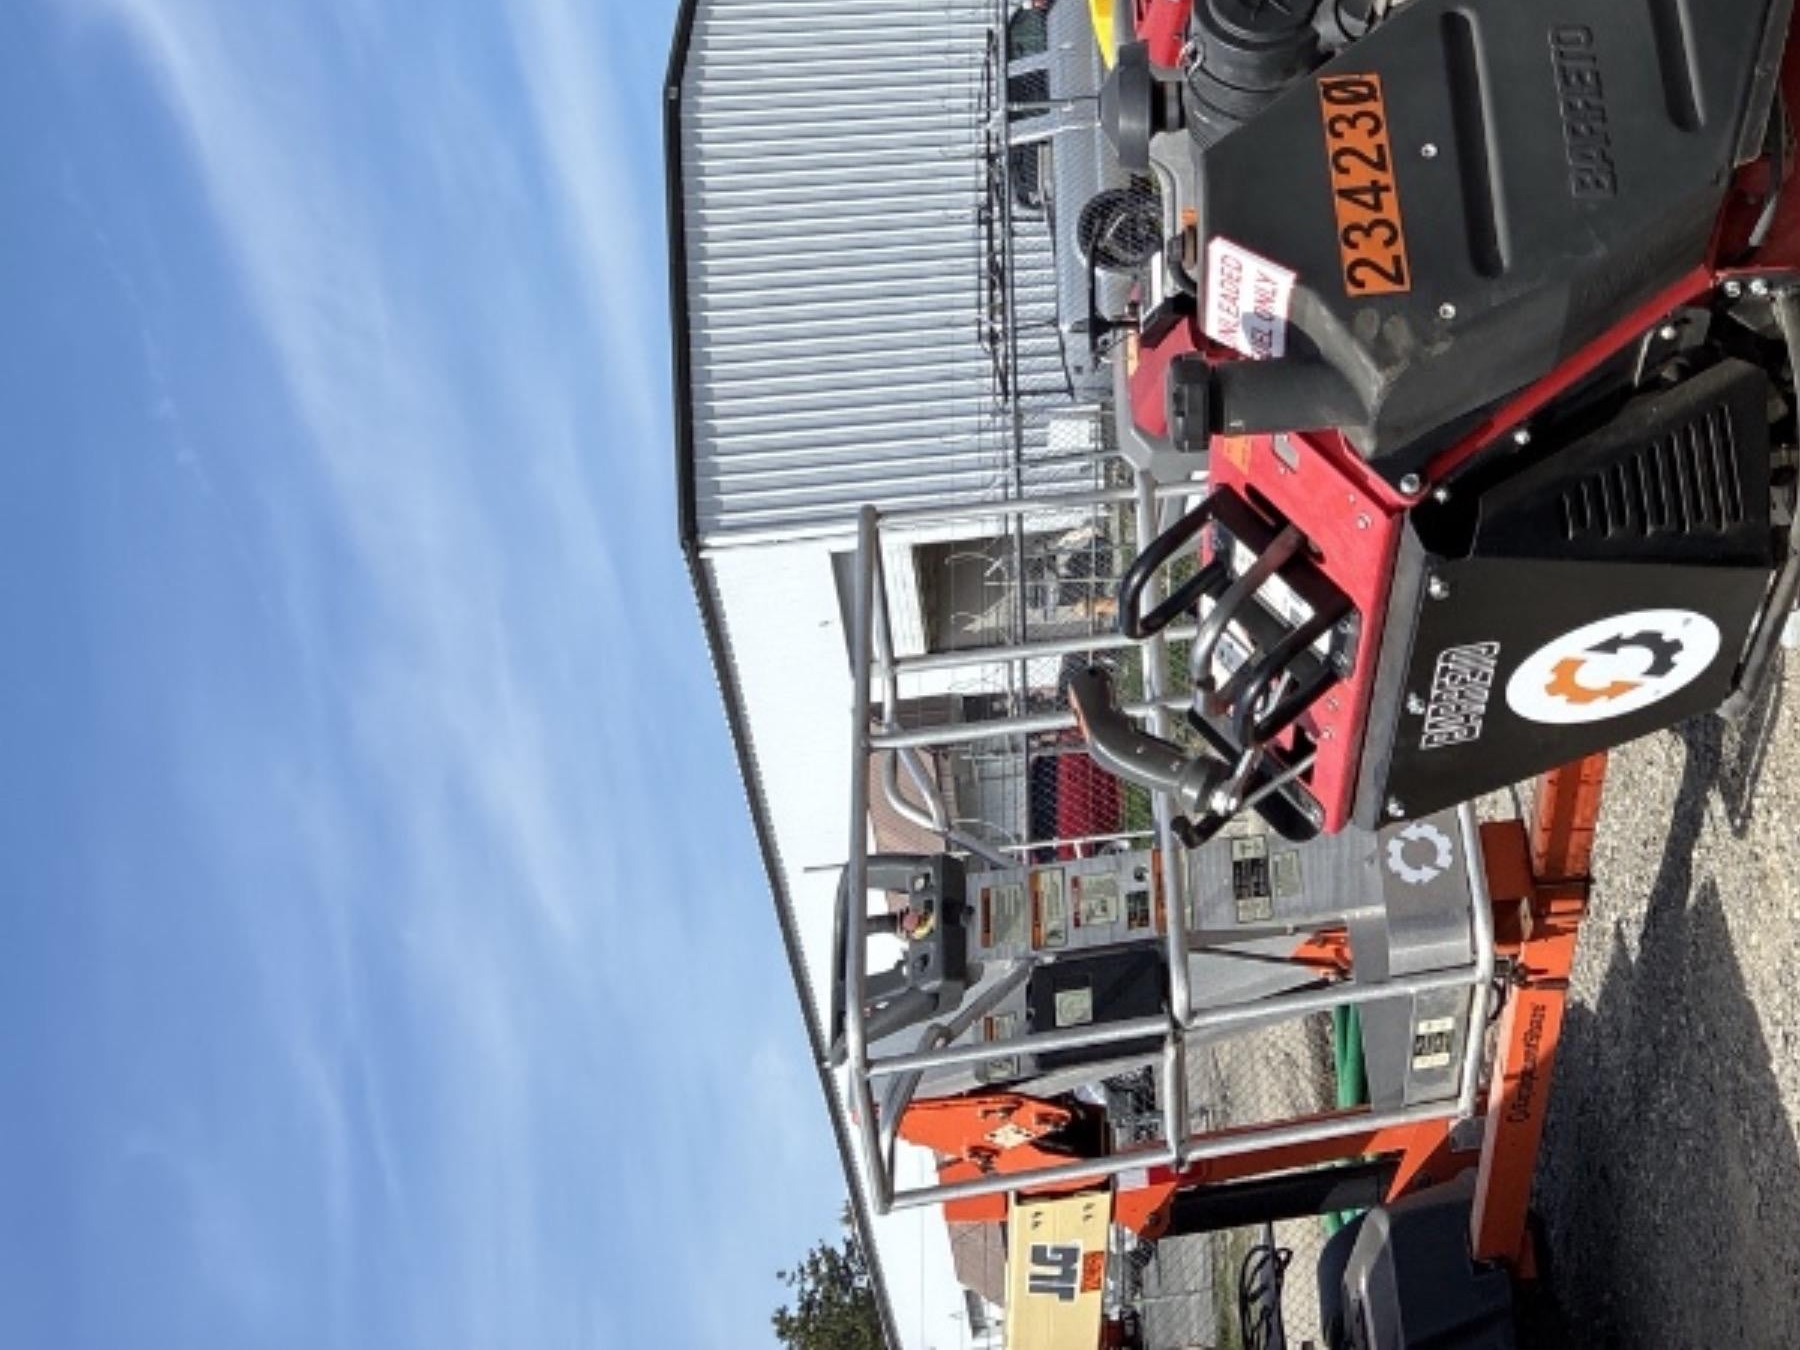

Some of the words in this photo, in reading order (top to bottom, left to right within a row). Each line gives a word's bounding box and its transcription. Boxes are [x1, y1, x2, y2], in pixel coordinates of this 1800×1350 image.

[1547, 24, 1618, 198] BARRETO
[1321, 79, 1405, 289] 234230
[1253, 269, 1278, 322] ONLY
[1419, 641, 1500, 750] BARRETO
[1028, 1244, 1080, 1302] JLG
